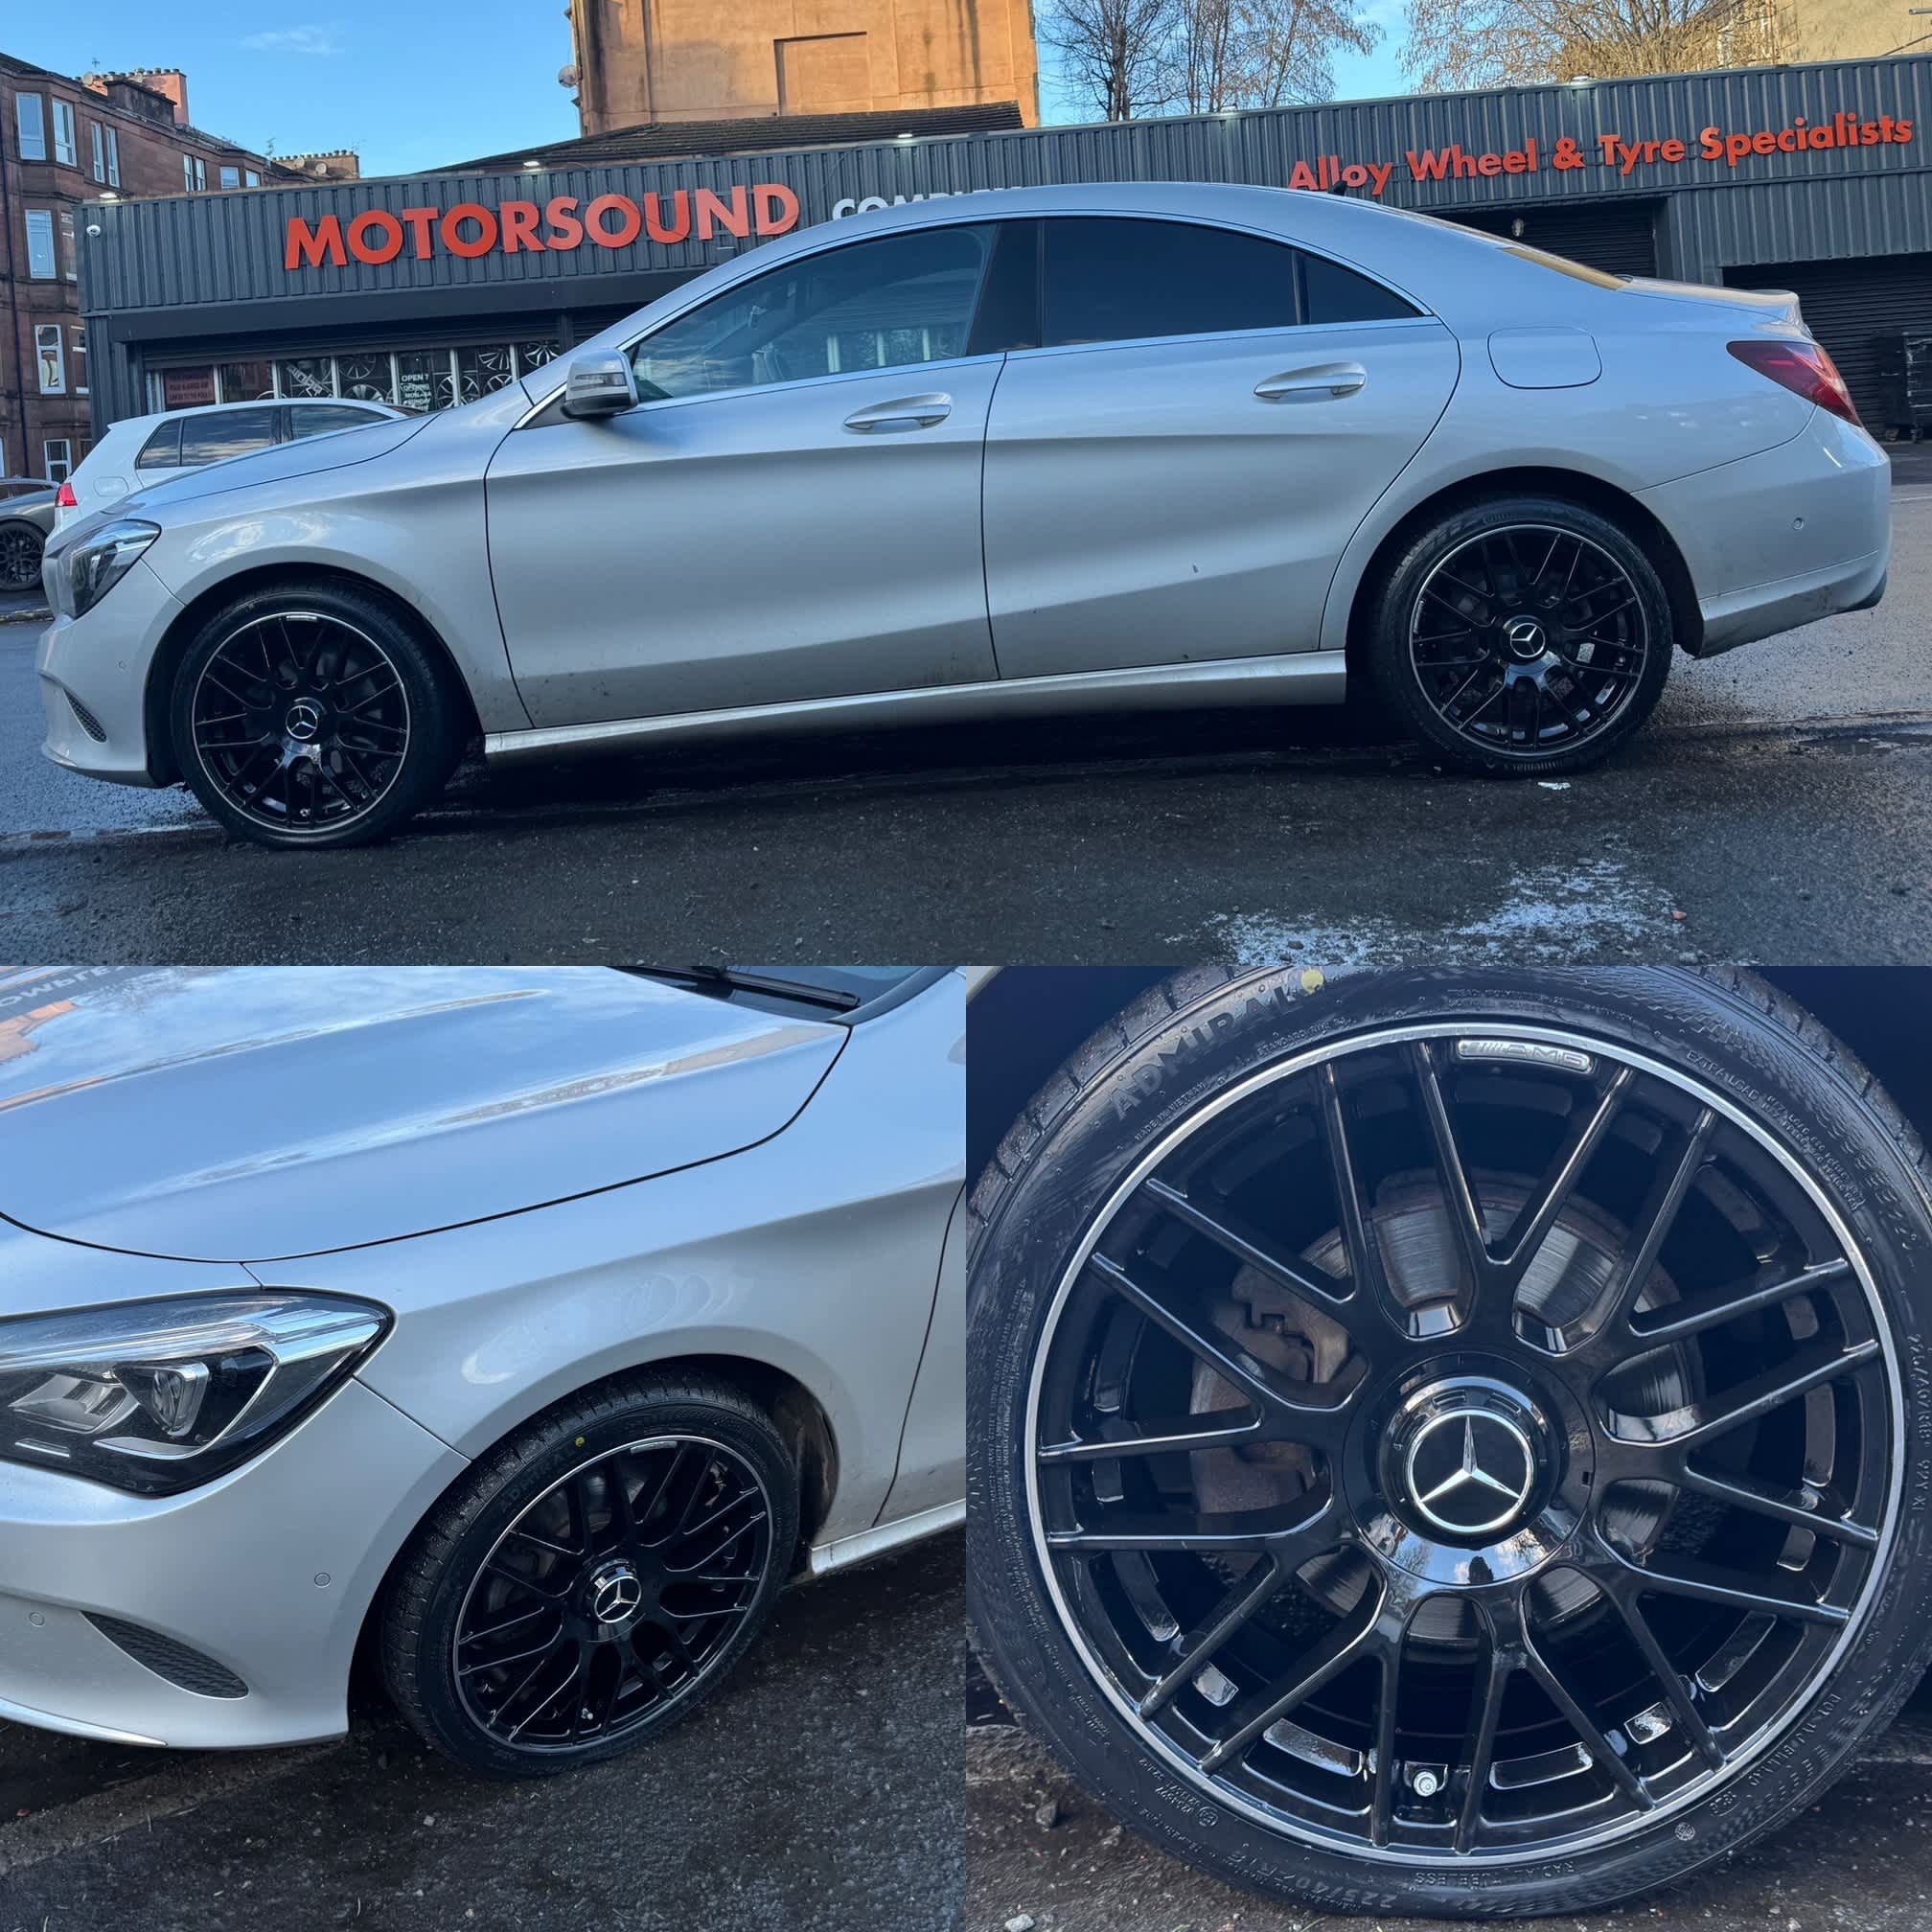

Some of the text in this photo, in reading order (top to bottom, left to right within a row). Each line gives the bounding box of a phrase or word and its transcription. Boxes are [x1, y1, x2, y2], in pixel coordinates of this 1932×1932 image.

[1288, 112, 1914, 196] Alloy Wheel & Tyre Specialists
[285, 183, 799, 269] MOTORSOUND
[1109, 986, 1297, 1119] ADMIRAL
